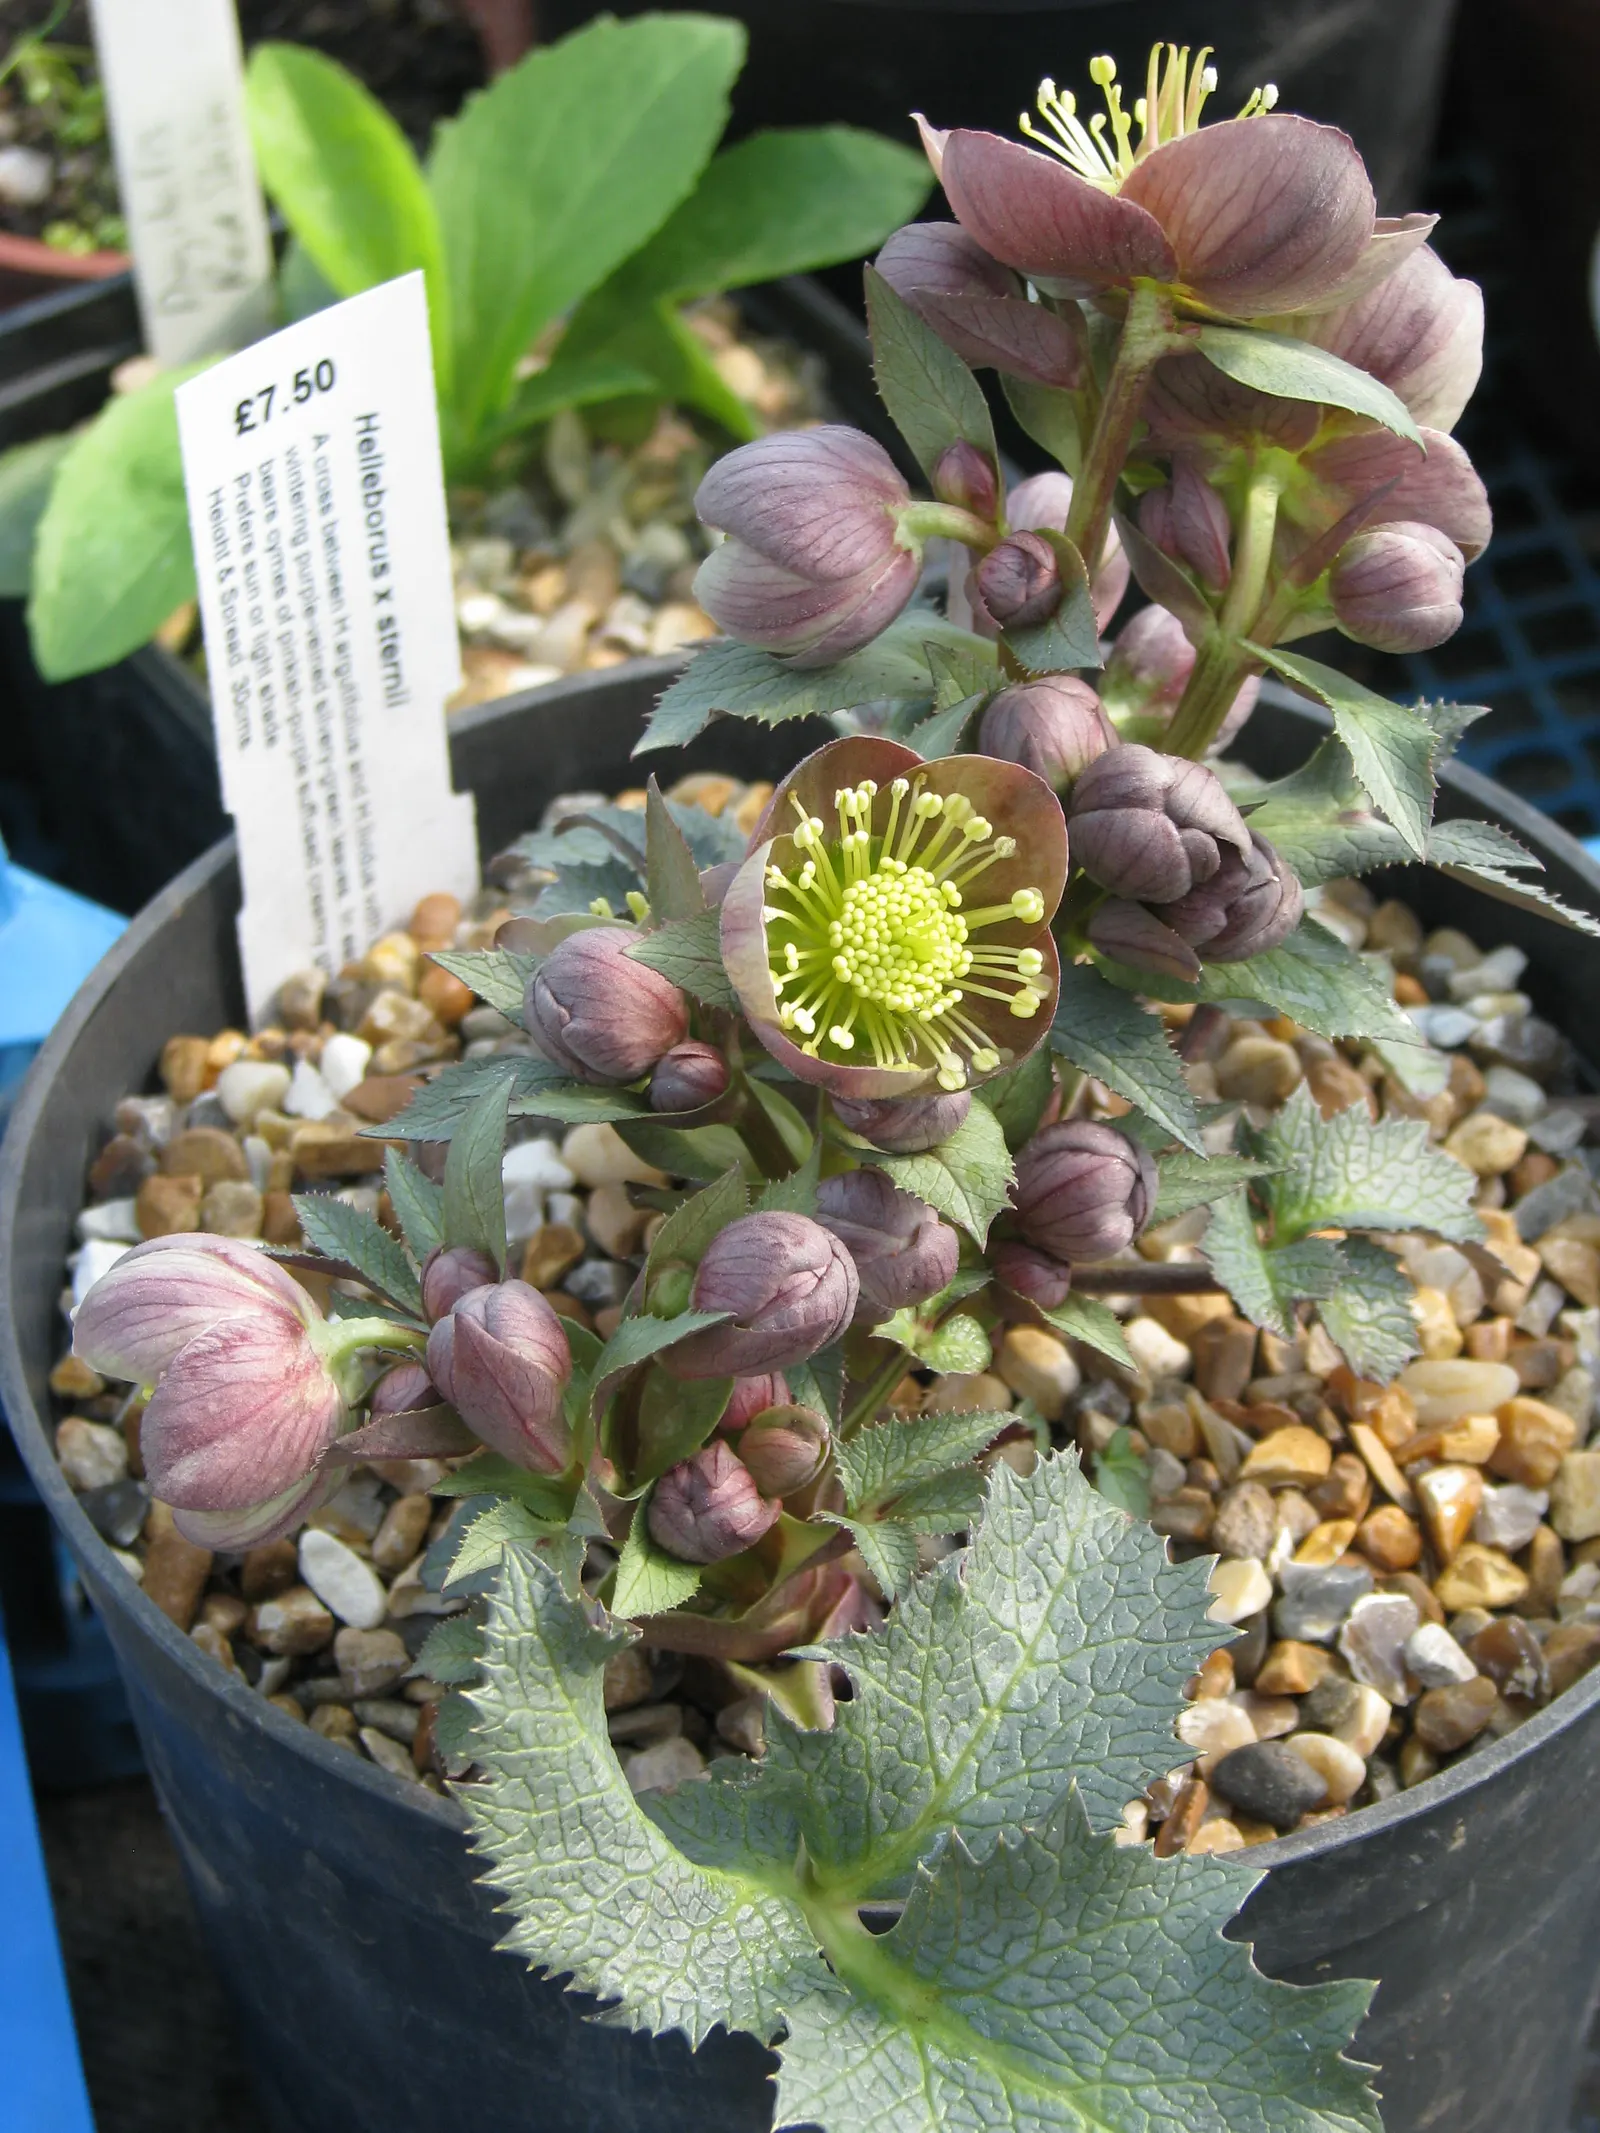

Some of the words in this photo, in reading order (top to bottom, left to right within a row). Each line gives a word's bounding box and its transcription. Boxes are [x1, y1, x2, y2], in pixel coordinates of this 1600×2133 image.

[233, 357, 337, 436] £7.50
[207, 486, 231, 563] Height
[232, 471, 256, 556] Prefers
[257, 457, 278, 524] bears
[283, 444, 309, 548] wintering
[312, 455, 334, 517] cross
[242, 558, 260, 601] sun
[263, 527, 288, 601] cymes
[320, 519, 345, 613] between
[353, 411, 390, 580] Helleborus
[375, 614, 409, 708] sternii
[248, 629, 273, 680] light
[292, 549, 330, 695] purple-veined
[274, 629, 310, 779] pinkish-purple
